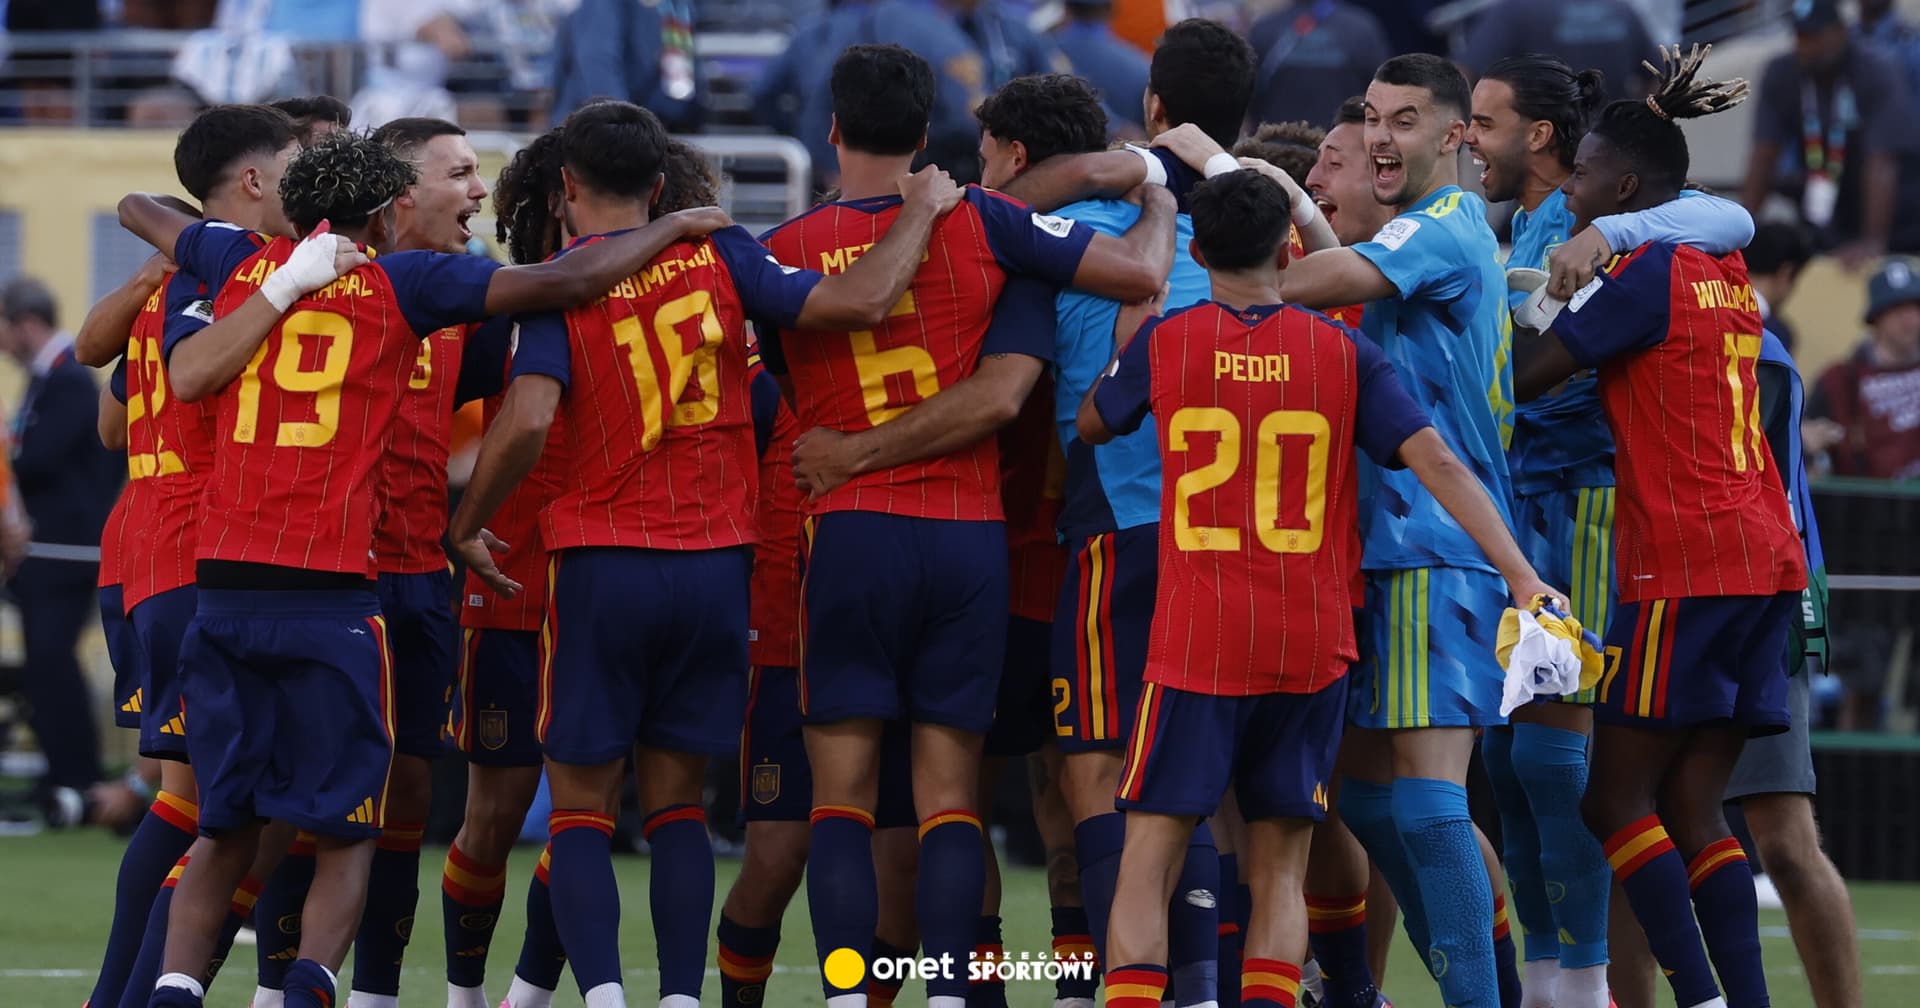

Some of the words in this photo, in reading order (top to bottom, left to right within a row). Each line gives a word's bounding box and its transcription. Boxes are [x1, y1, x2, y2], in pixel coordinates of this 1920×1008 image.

[313, 274, 374, 301] AMAL
[232, 310, 354, 448] 19
[611, 289, 724, 451] 18
[849, 289, 940, 427] 6
[1214, 350, 1290, 383] PEDRI
[1723, 332, 1765, 472] 17
[1169, 406, 1331, 554] 20
